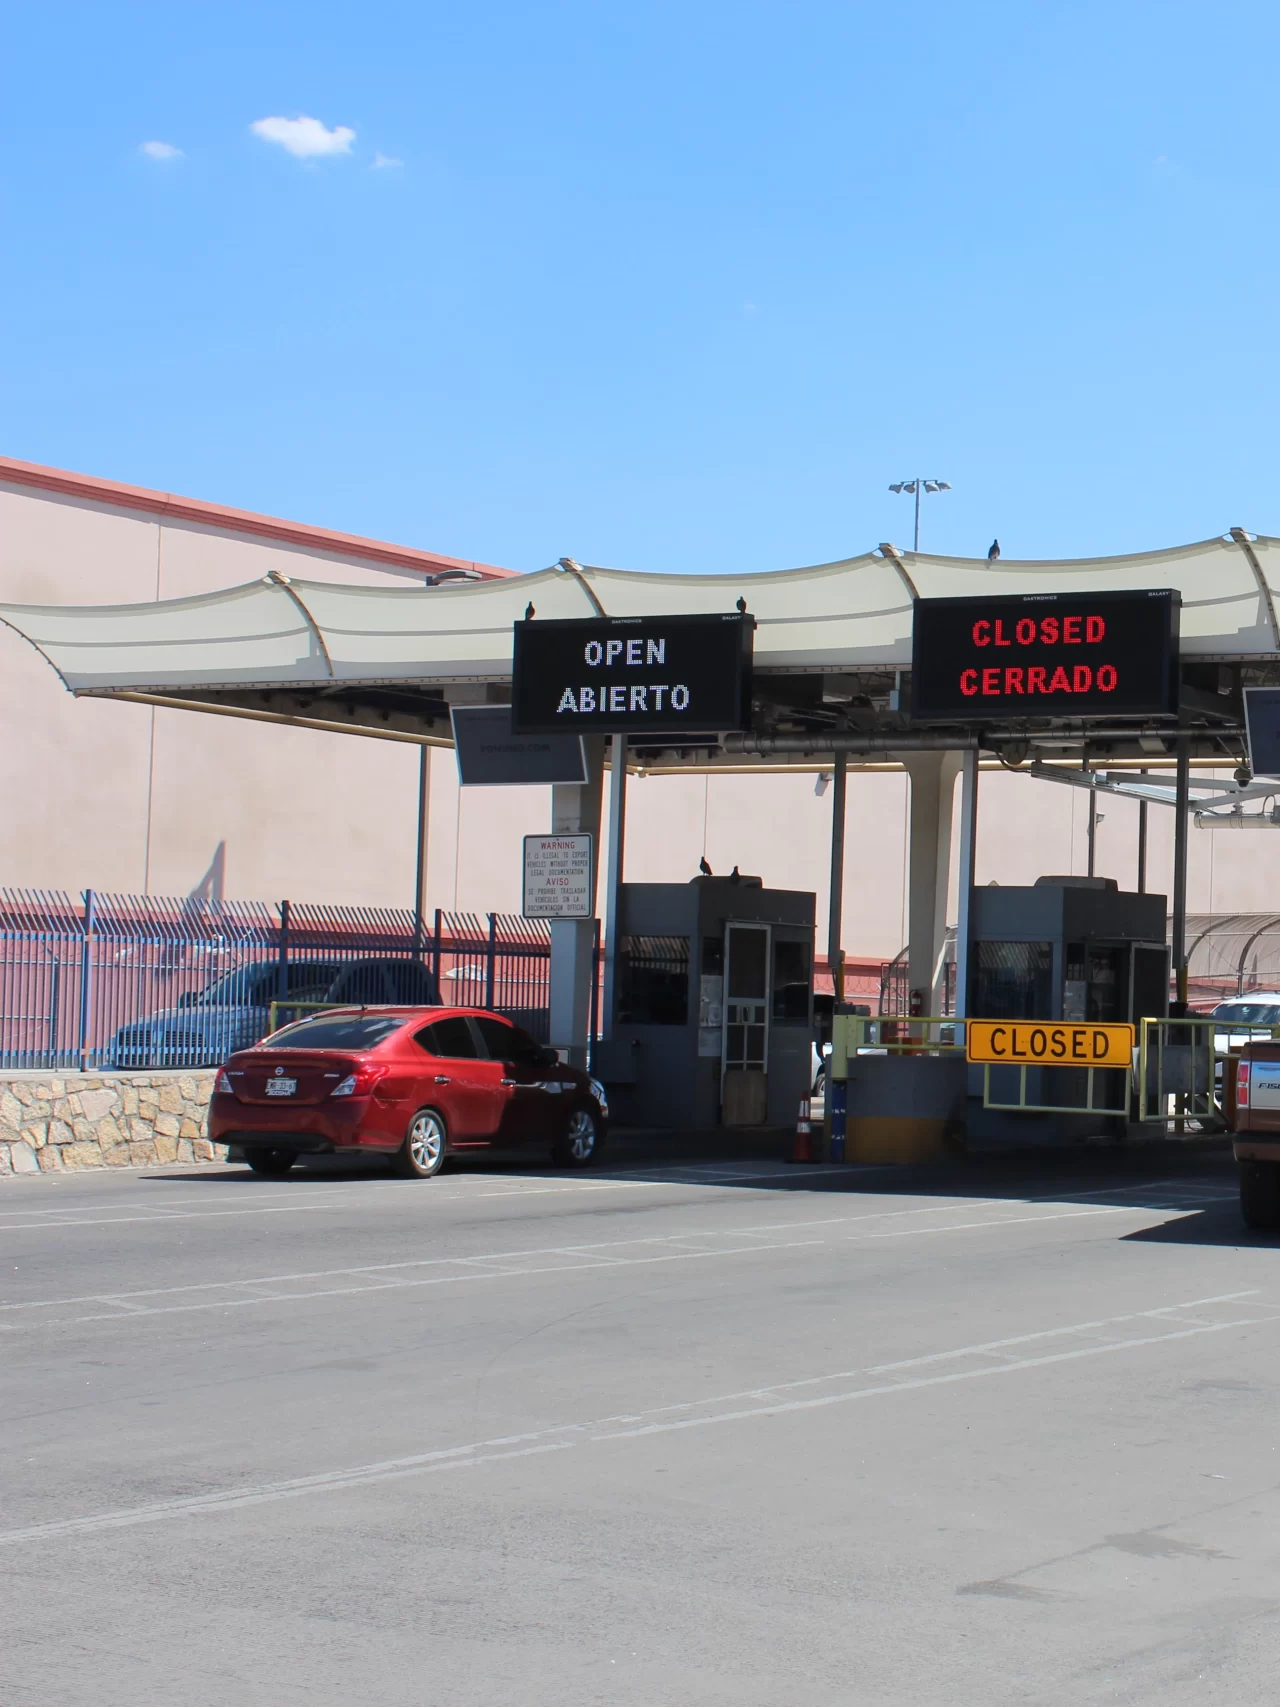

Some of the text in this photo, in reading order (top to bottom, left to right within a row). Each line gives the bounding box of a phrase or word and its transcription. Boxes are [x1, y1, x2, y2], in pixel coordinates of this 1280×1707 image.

[972, 615, 1105, 647] CLOSED
[584, 638, 665, 666] OPEN
[959, 664, 1118, 696] CERRADO
[556, 684, 690, 713] ABIERTO
[541, 842, 575, 850] WARNING
[545, 878, 569, 886] AVISO
[549, 868, 584, 876] DOCUMENTATION
[990, 1027, 1110, 1059] CLOSED
